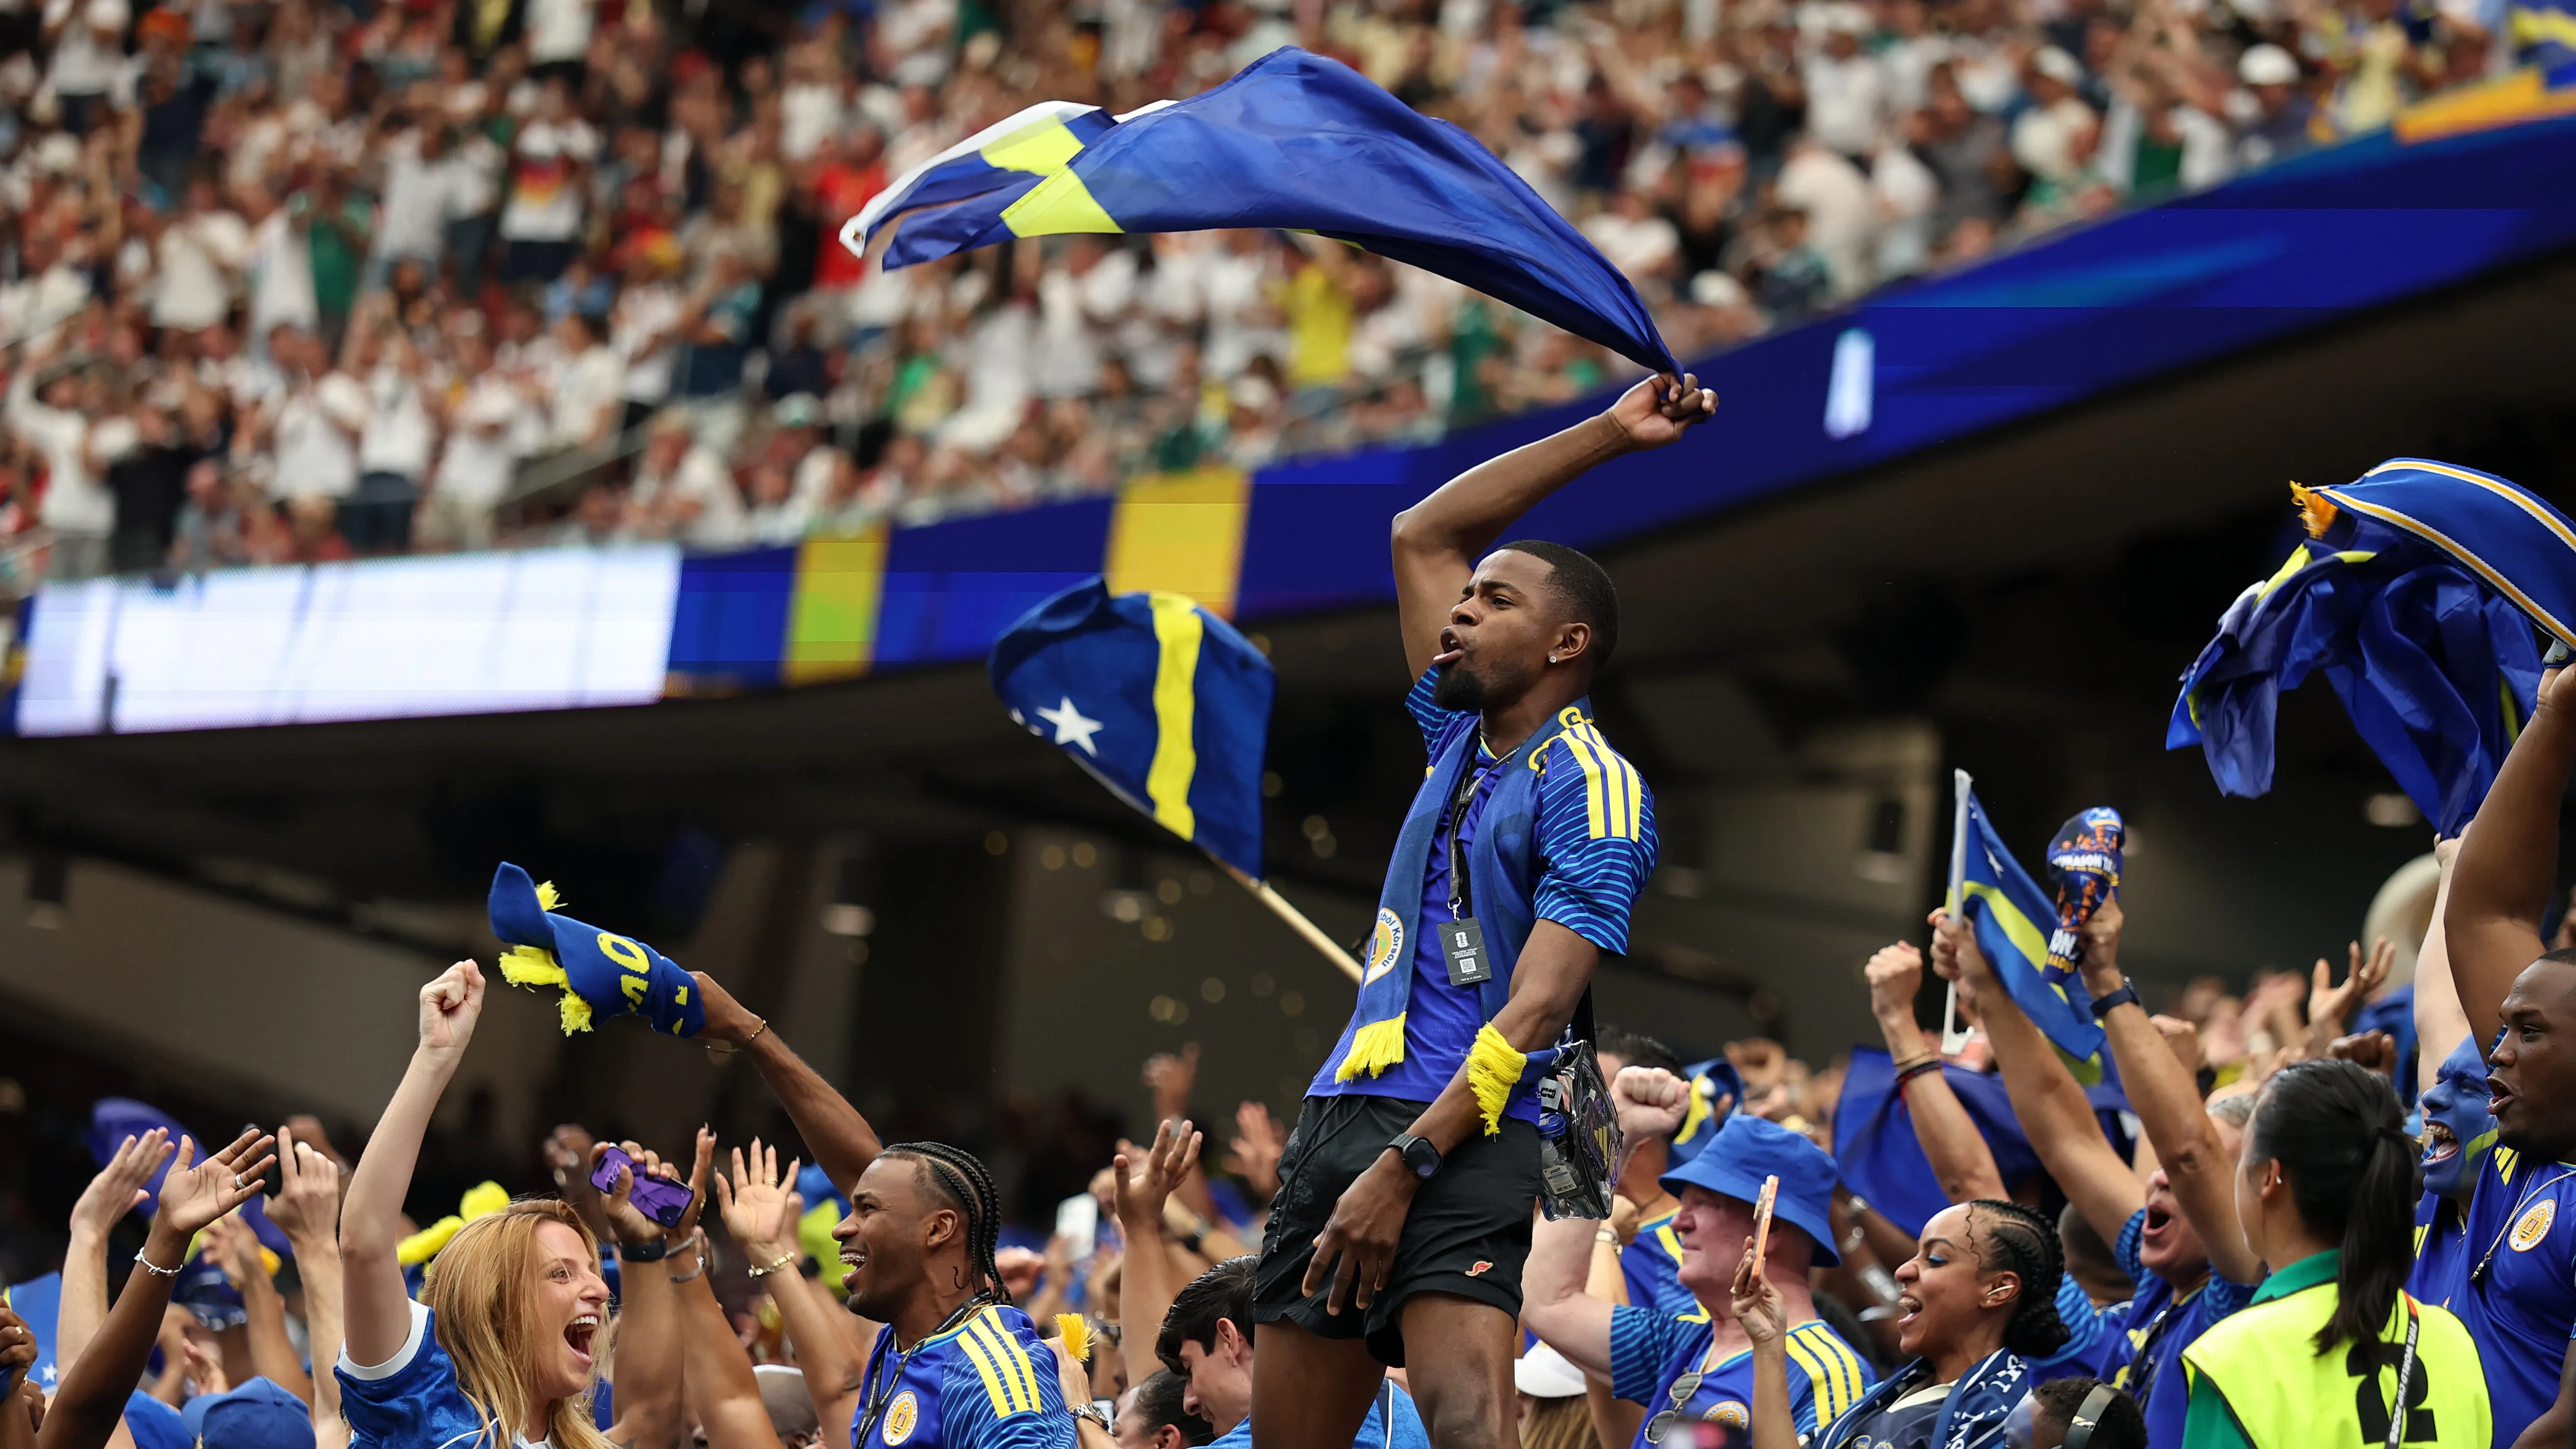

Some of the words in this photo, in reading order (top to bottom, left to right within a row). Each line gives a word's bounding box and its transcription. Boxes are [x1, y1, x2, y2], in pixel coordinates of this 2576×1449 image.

[2408, 1321, 2418, 1346] FIFA
[2400, 1344, 2414, 1384] WORLD
[2397, 1382, 2408, 1404] CUP
[2389, 1402, 2404, 1444] 2026
